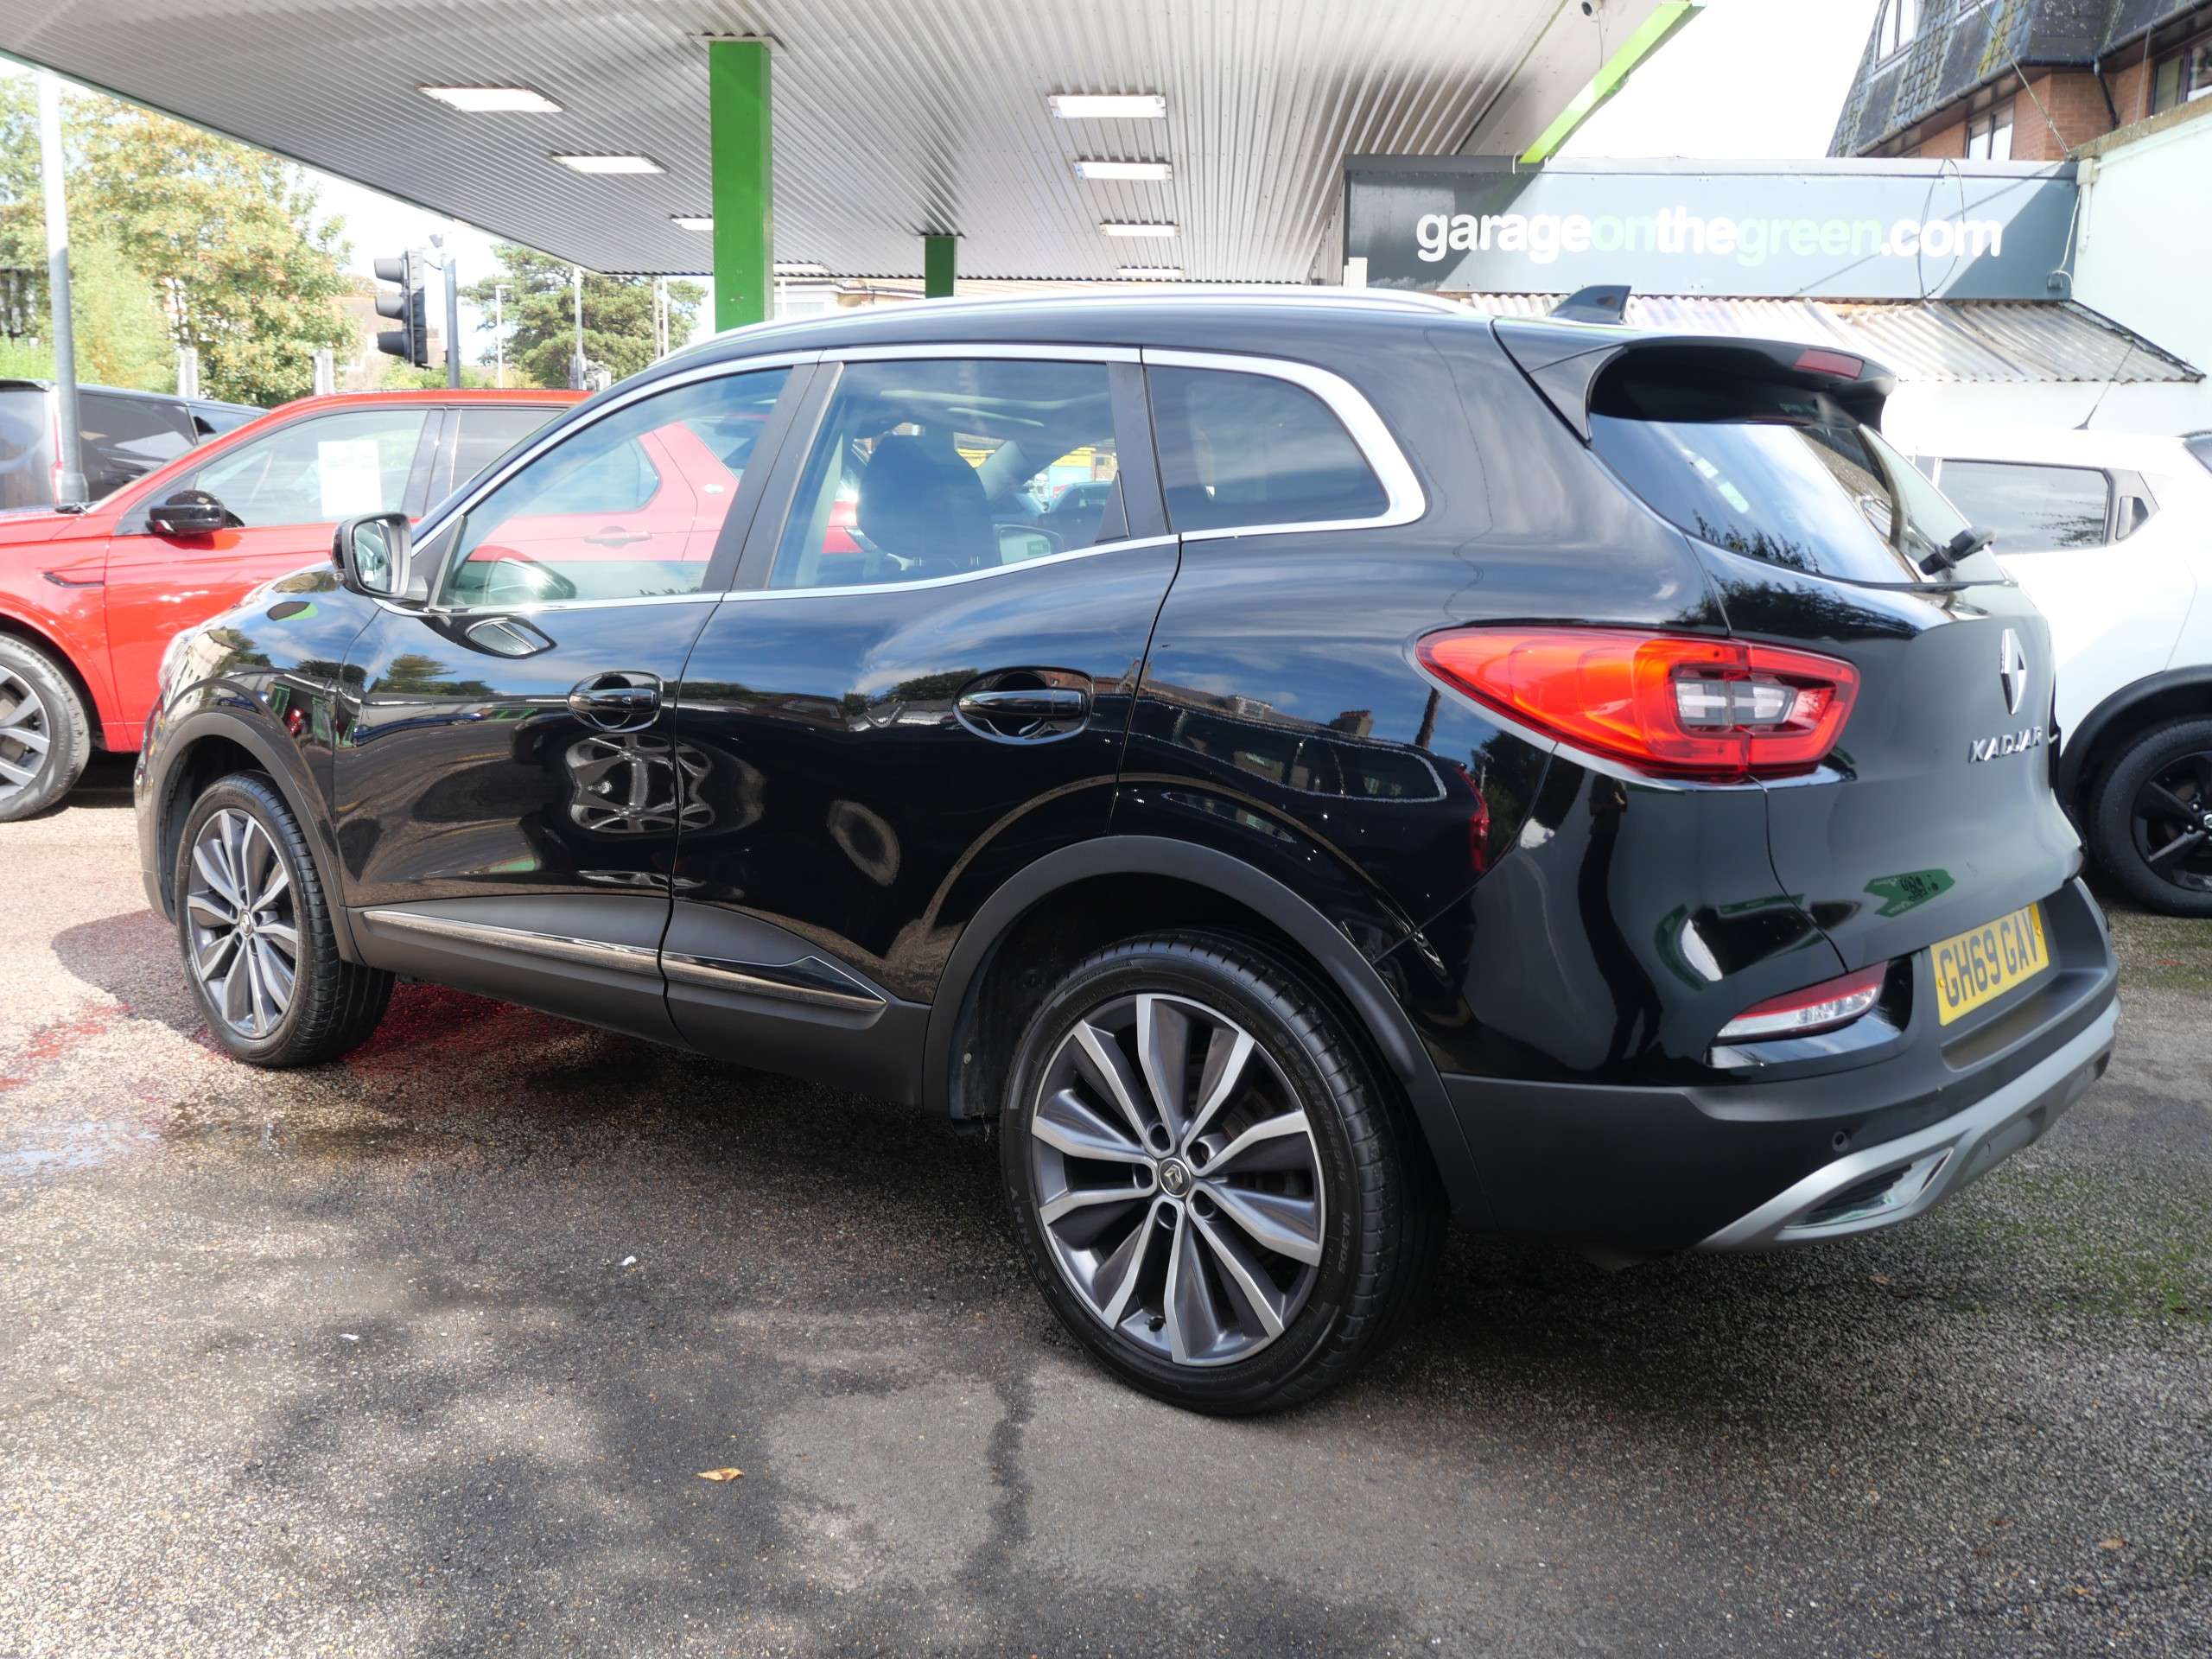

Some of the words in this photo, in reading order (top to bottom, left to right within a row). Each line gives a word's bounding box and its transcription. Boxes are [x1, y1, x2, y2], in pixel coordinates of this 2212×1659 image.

[1416, 207, 2002, 265] garageonthegreen.com
[1968, 726, 2043, 763] KADJAR
[1940, 929, 2002, 1007] GH69
[2000, 910, 2038, 976] GAV
